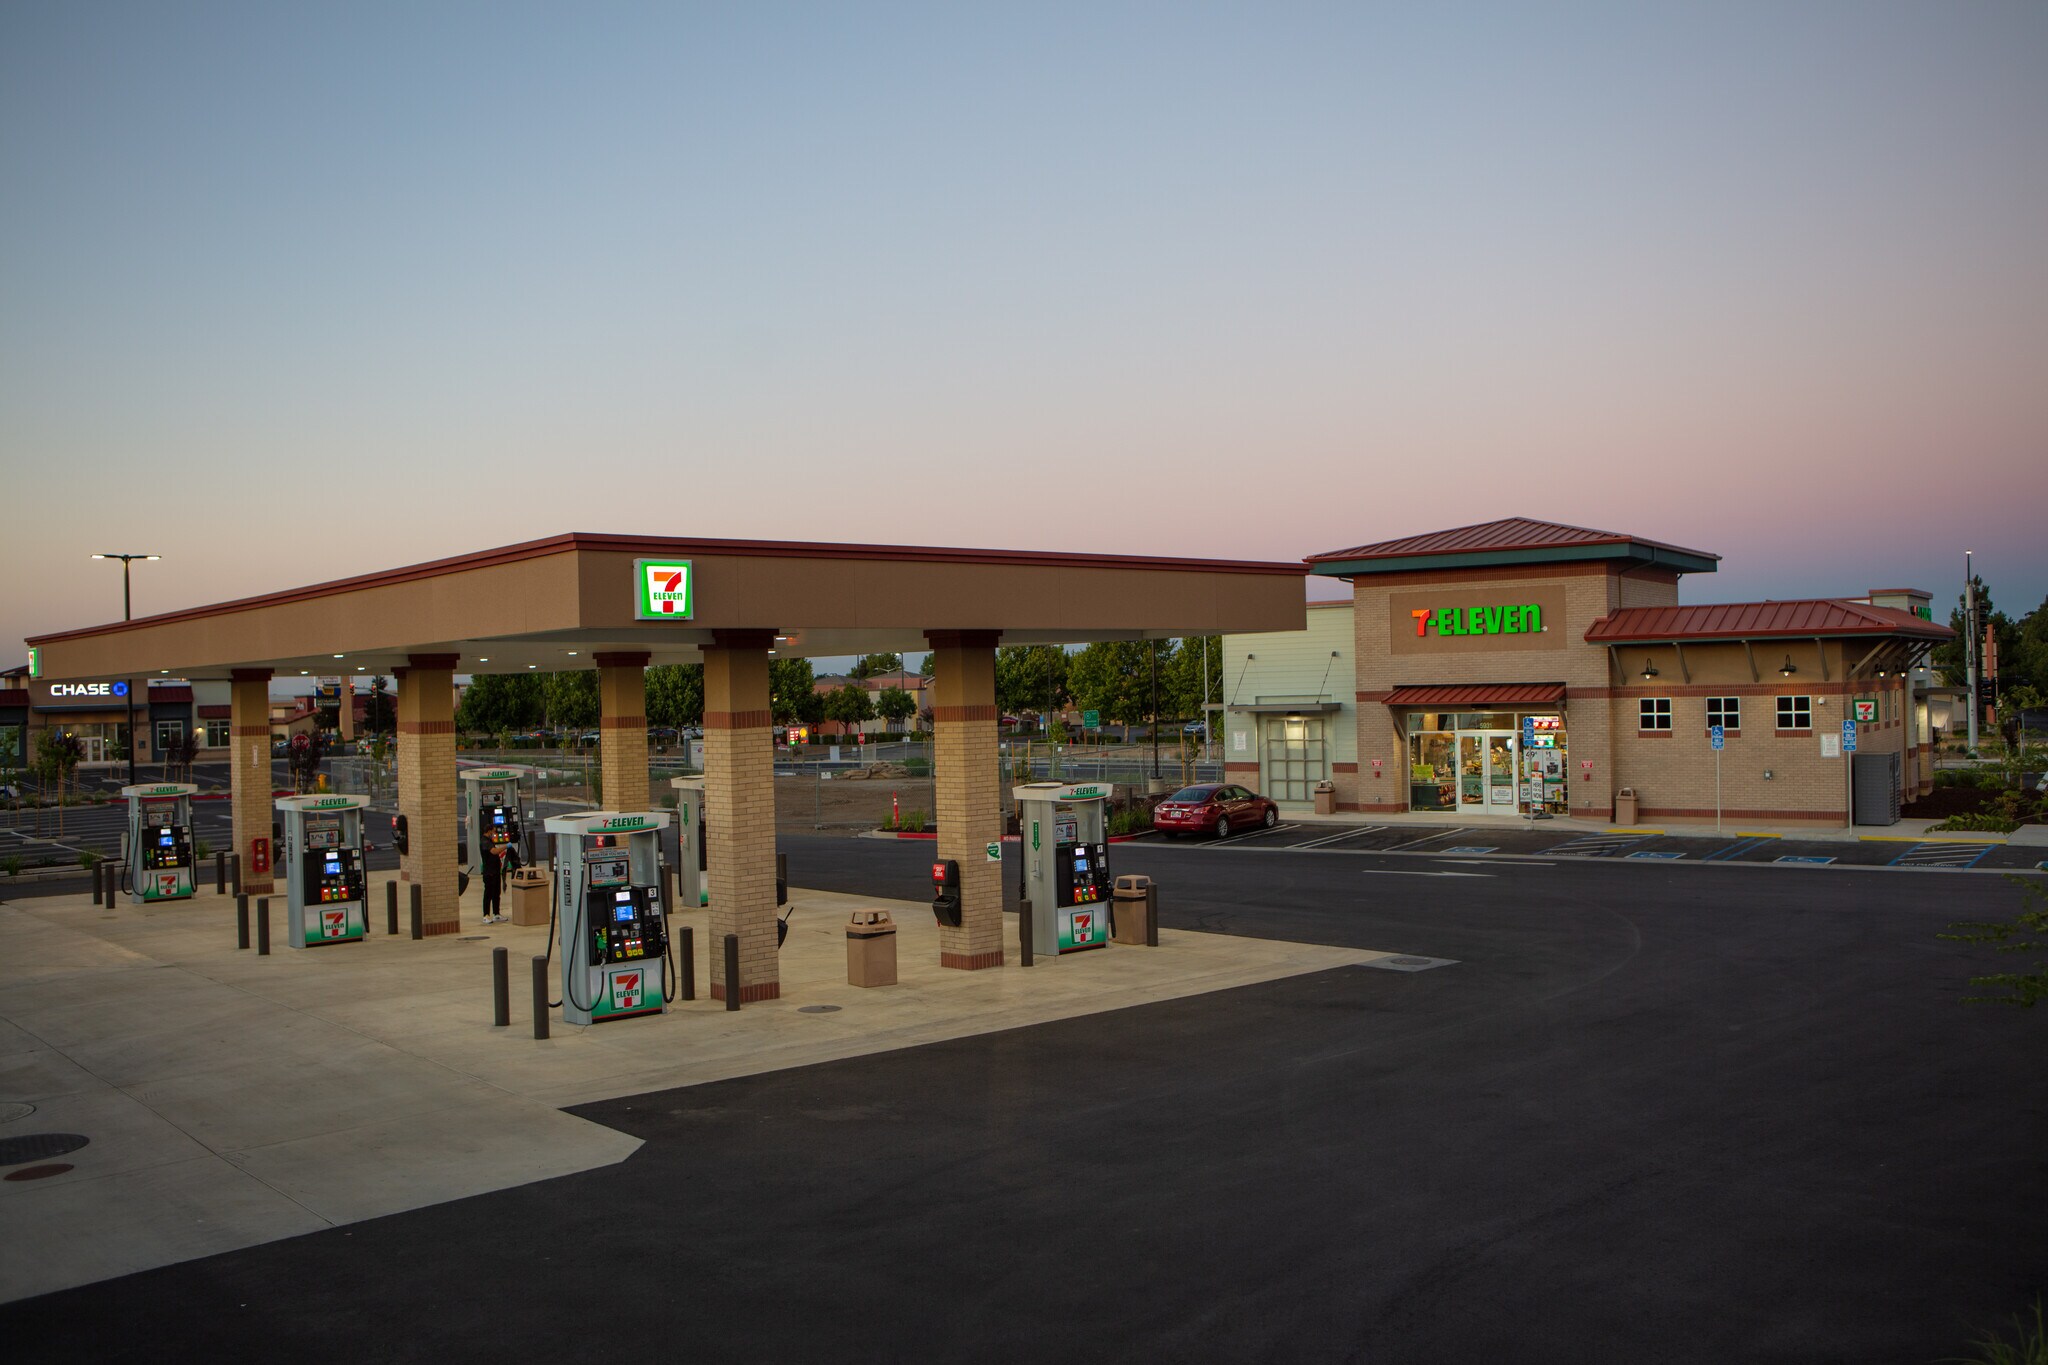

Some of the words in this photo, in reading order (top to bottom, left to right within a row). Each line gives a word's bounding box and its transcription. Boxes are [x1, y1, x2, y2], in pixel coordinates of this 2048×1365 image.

[653, 571, 682, 613] 7
[50, 683, 111, 696] CHASE
[650, 888, 656, 896] 3
